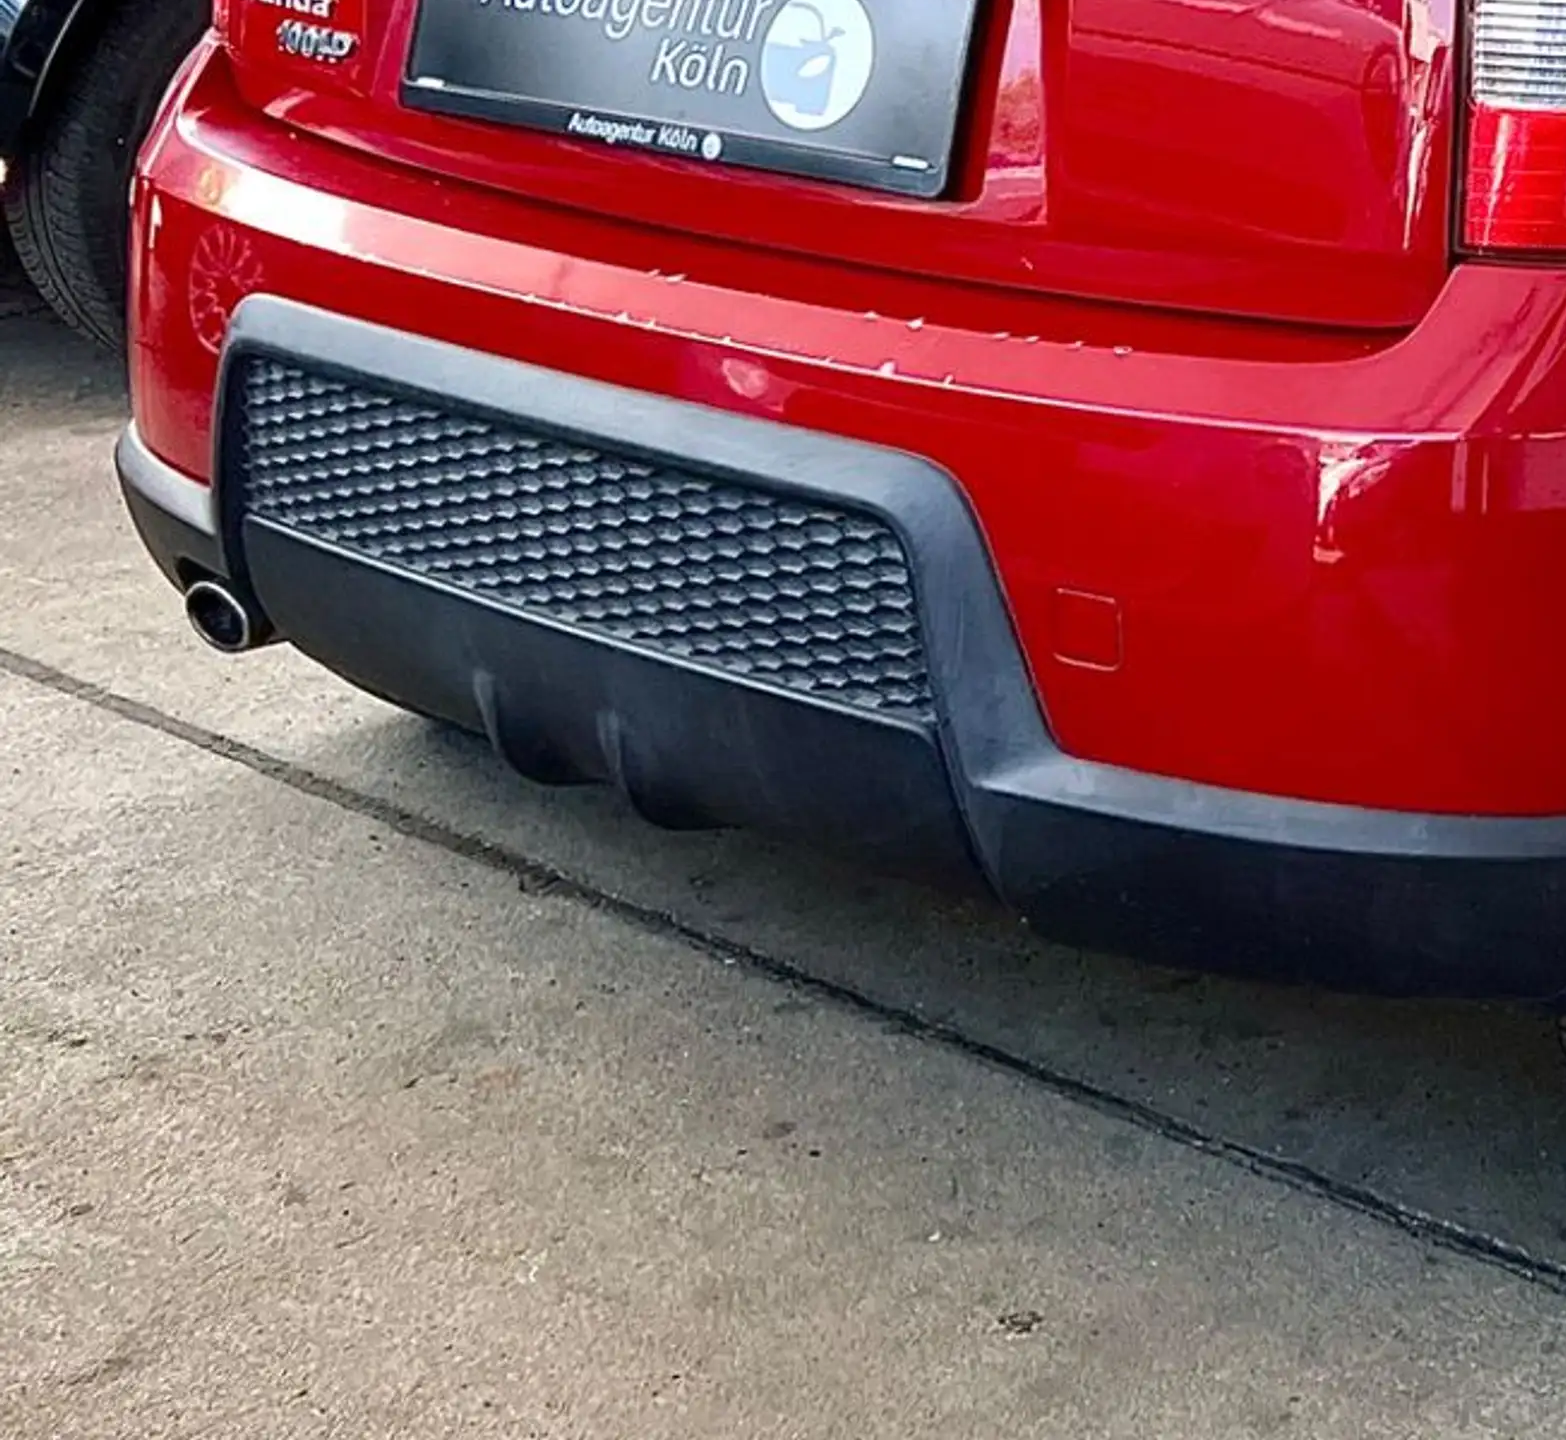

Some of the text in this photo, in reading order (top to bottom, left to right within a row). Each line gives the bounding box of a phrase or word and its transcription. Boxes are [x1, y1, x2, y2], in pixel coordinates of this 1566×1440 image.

[649, 37, 750, 96] Köln
[567, 111, 698, 152] Autoagentur Köln
